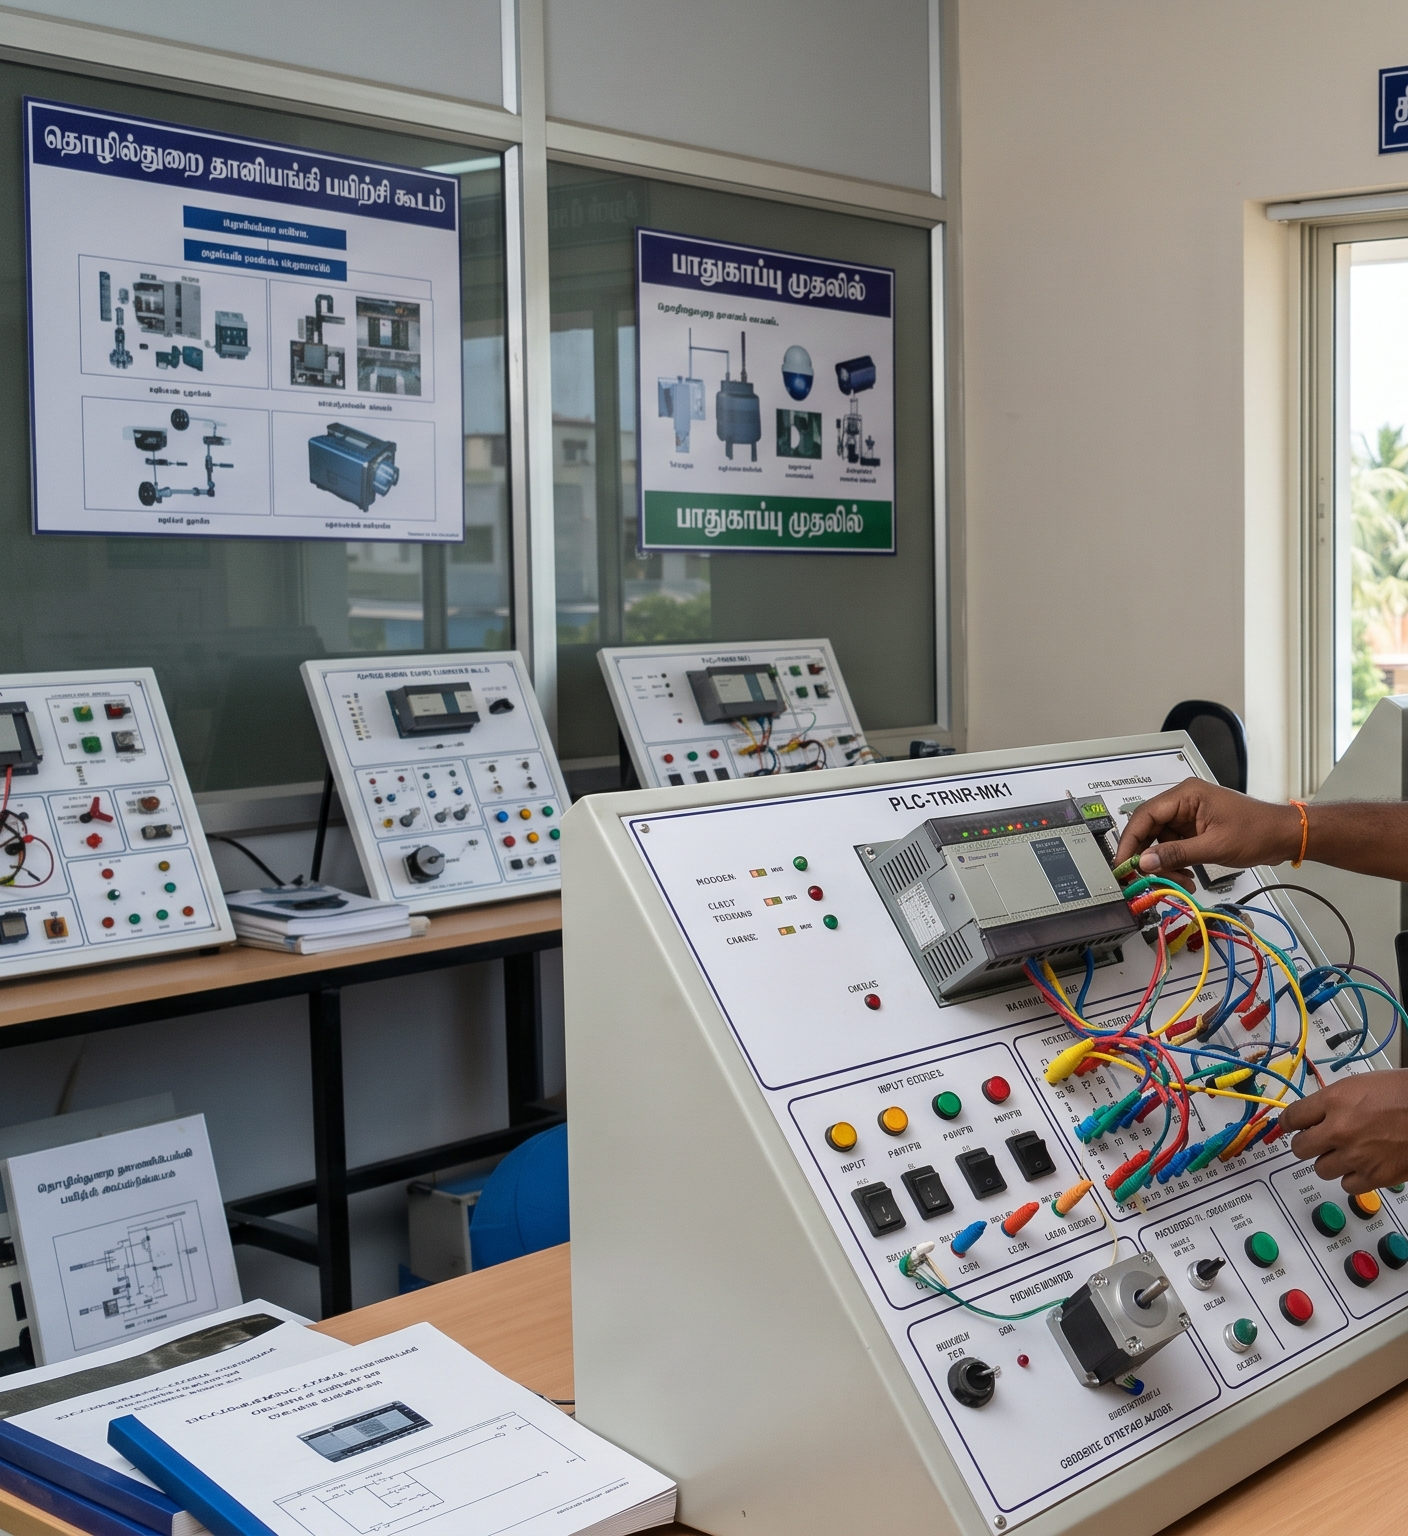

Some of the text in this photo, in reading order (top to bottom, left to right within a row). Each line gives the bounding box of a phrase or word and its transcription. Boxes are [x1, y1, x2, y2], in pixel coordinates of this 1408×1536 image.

[44, 125, 446, 213] தொழில்துறை தானியங்கி பயிற்சி கூடம்
[672, 252, 866, 301] பாதுகாப்பு முதலில்
[676, 501, 864, 538] பாதுகாப்பு முதலில்
[888, 782, 1013, 812] PLC-TRNR-MK1
[840, 1159, 867, 1174] INPUT
